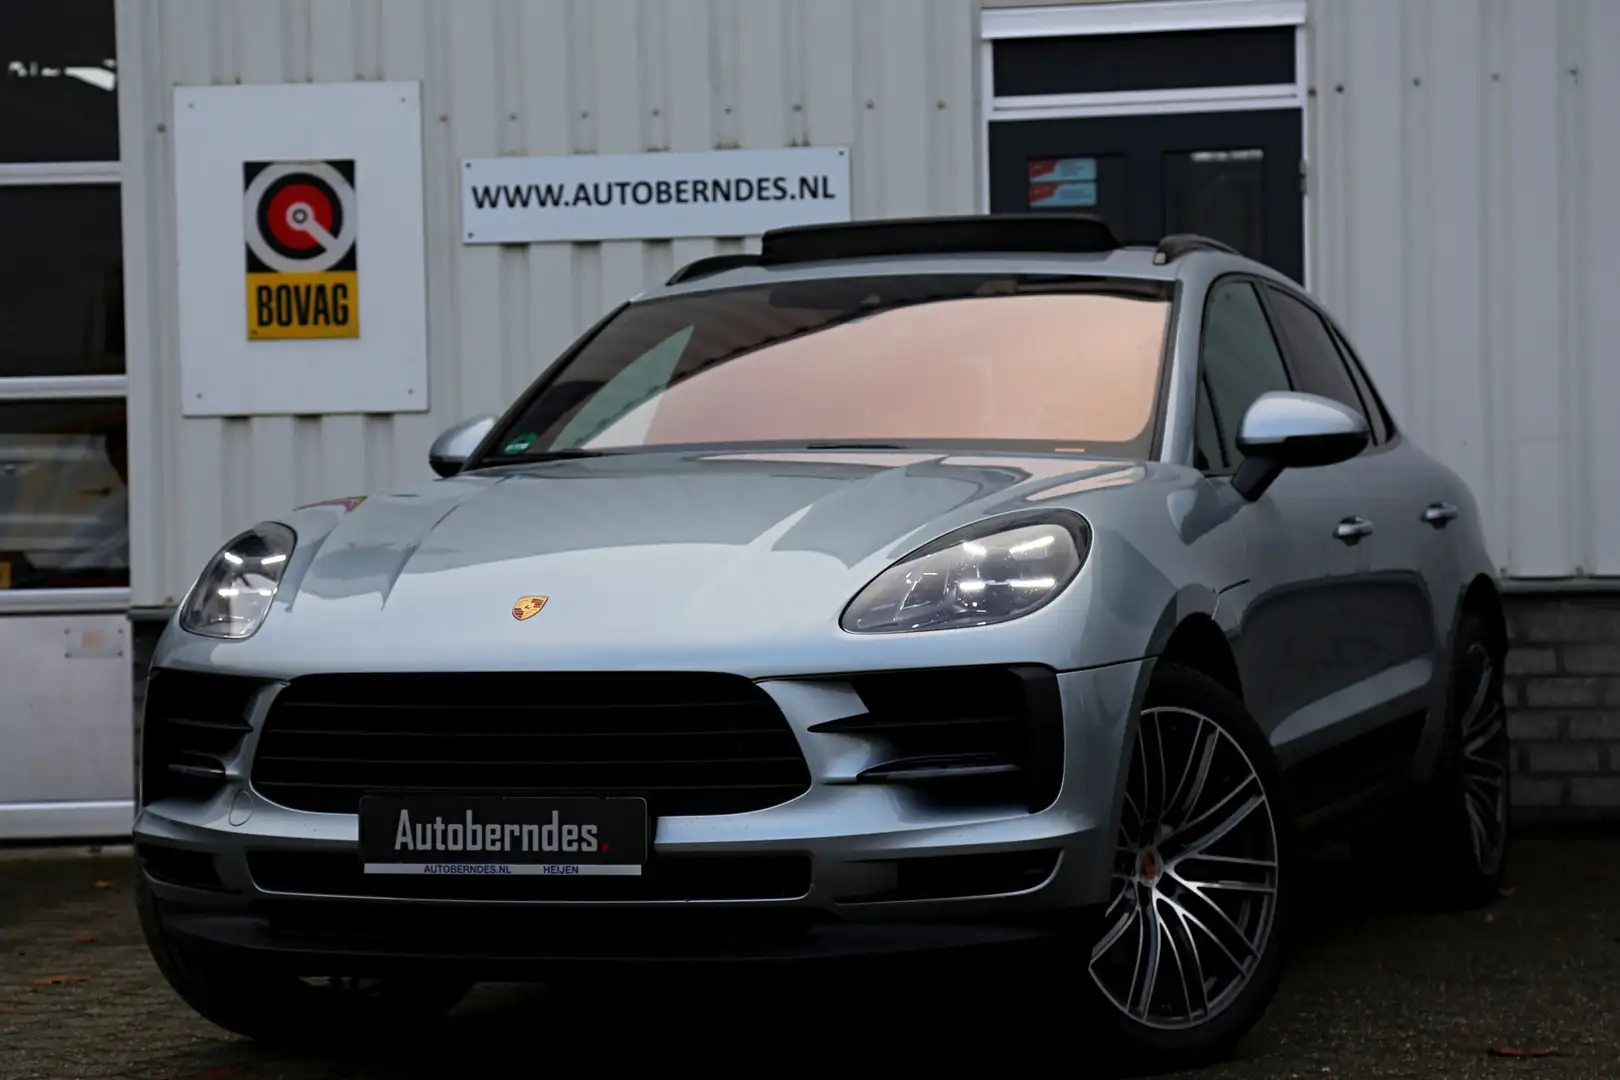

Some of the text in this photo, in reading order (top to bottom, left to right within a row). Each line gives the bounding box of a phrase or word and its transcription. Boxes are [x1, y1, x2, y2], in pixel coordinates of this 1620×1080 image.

[472, 175, 836, 209] WWW.AUTOBERNDES.NL
[257, 283, 349, 326] BOVAG
[424, 865, 578, 875] AUTOBERNDES.NL HEIJEN
